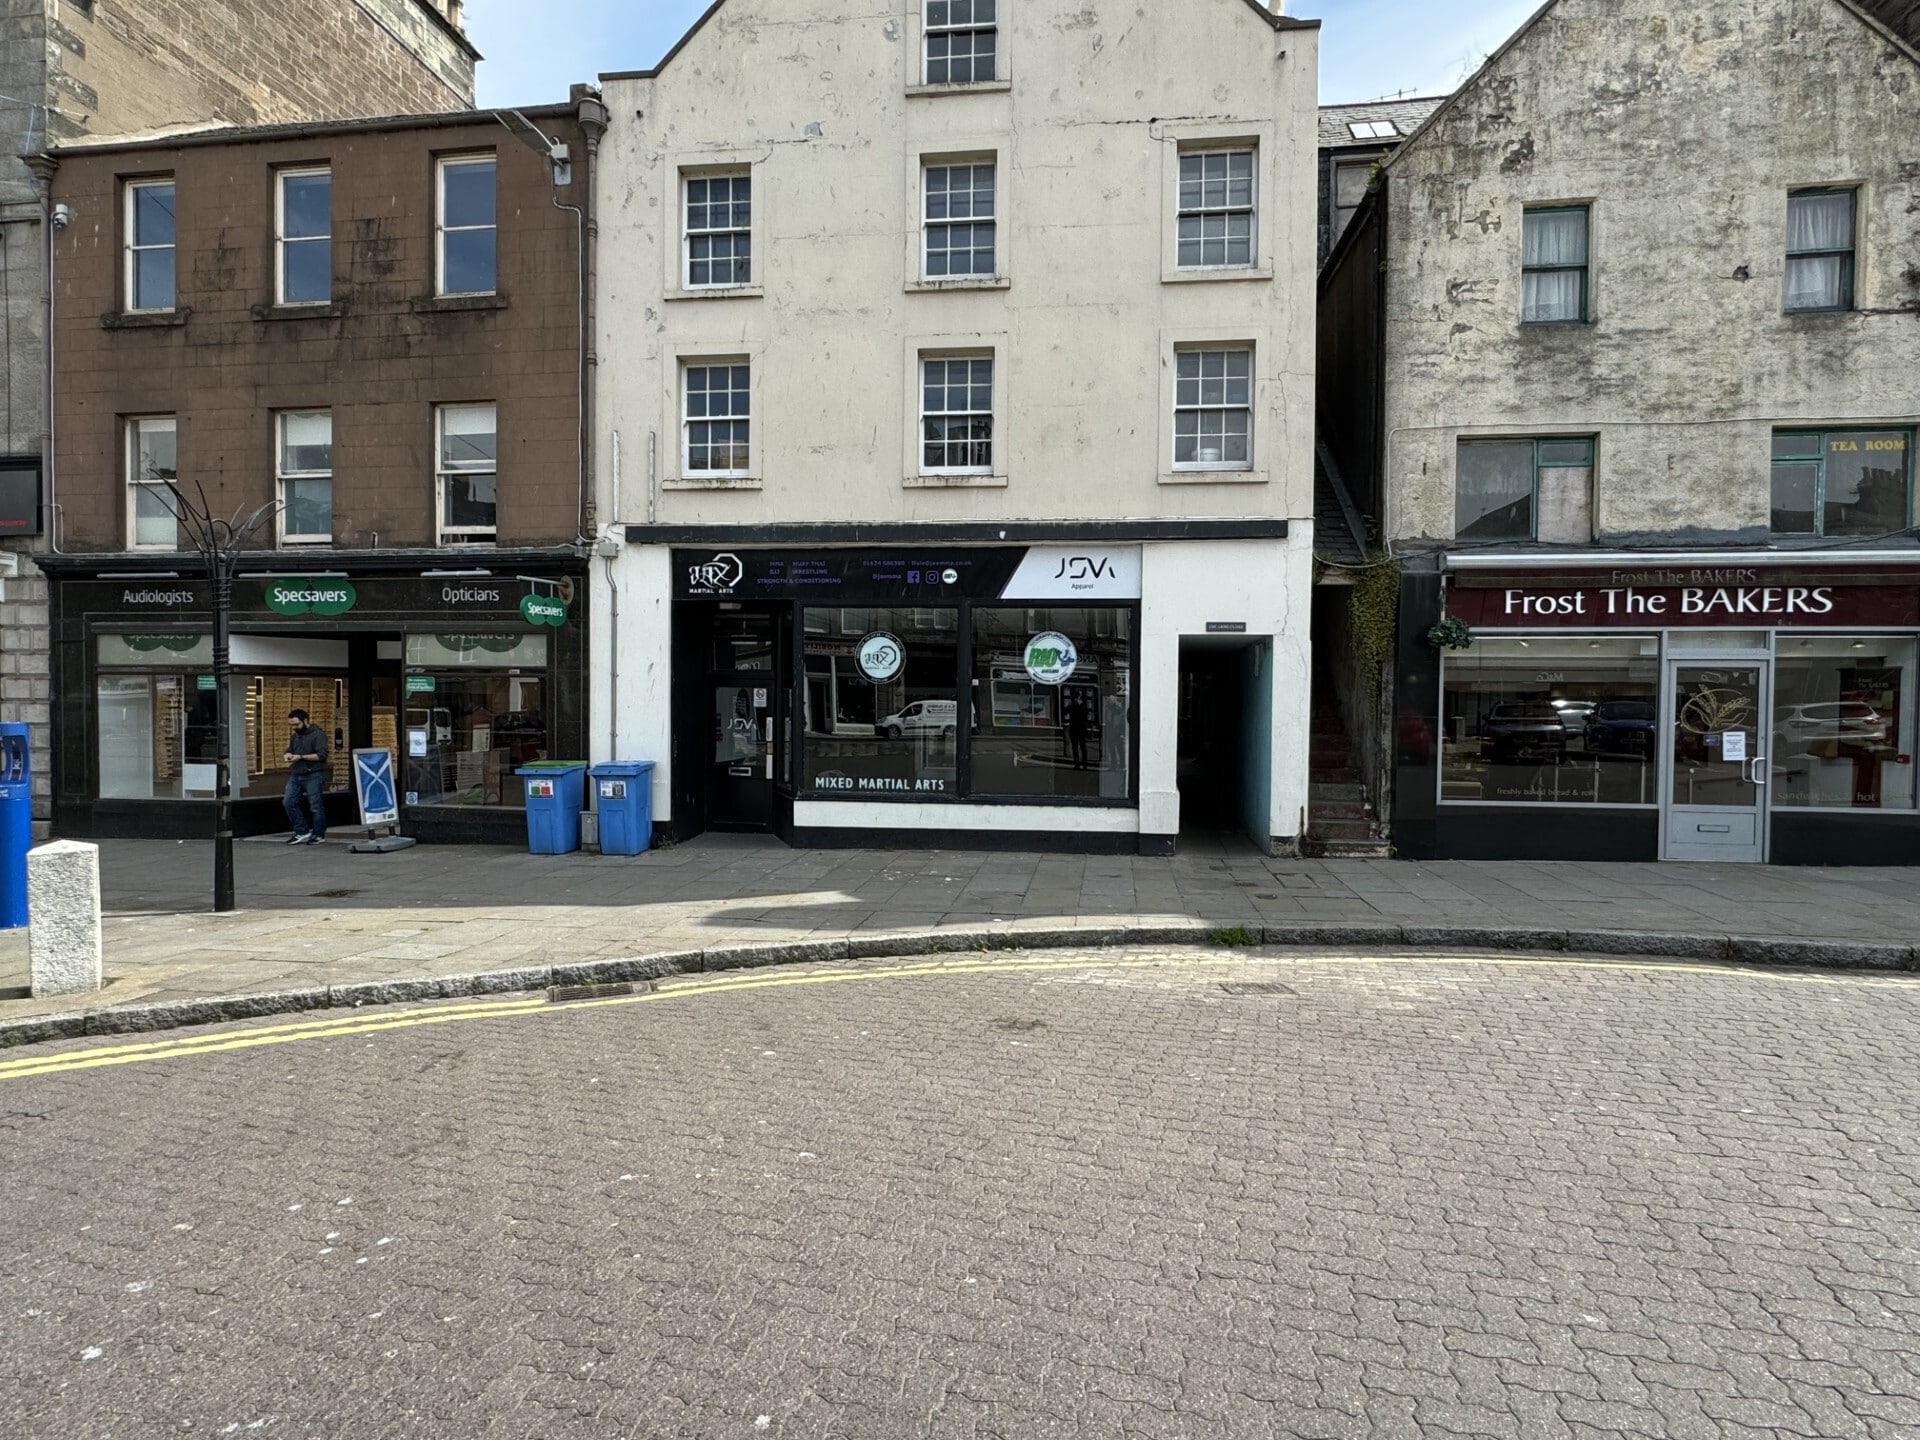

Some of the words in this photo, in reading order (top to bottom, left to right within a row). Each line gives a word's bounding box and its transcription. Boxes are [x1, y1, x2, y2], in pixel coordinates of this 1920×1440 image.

[1830, 440, 1857, 452] TEA
[1865, 440, 1905, 451] ROOM
[1612, 570, 1649, 584] Frost
[1655, 569, 1685, 584] The
[1690, 568, 1757, 584] BAKERS
[1071, 583, 1095, 591] Apparel
[123, 589, 194, 606] Audiologists
[273, 587, 348, 605] Specsavers
[442, 587, 500, 604] Opticians
[1504, 589, 1587, 614] Frost
[1599, 587, 1666, 614] The
[1680, 587, 1833, 614] BAKERS
[526, 602, 563, 617] Specsavers
[815, 777, 854, 789] MIXED
[858, 778, 911, 790] MARTIAL
[915, 779, 945, 791] ARTS
[1857, 791, 1877, 802] hot
